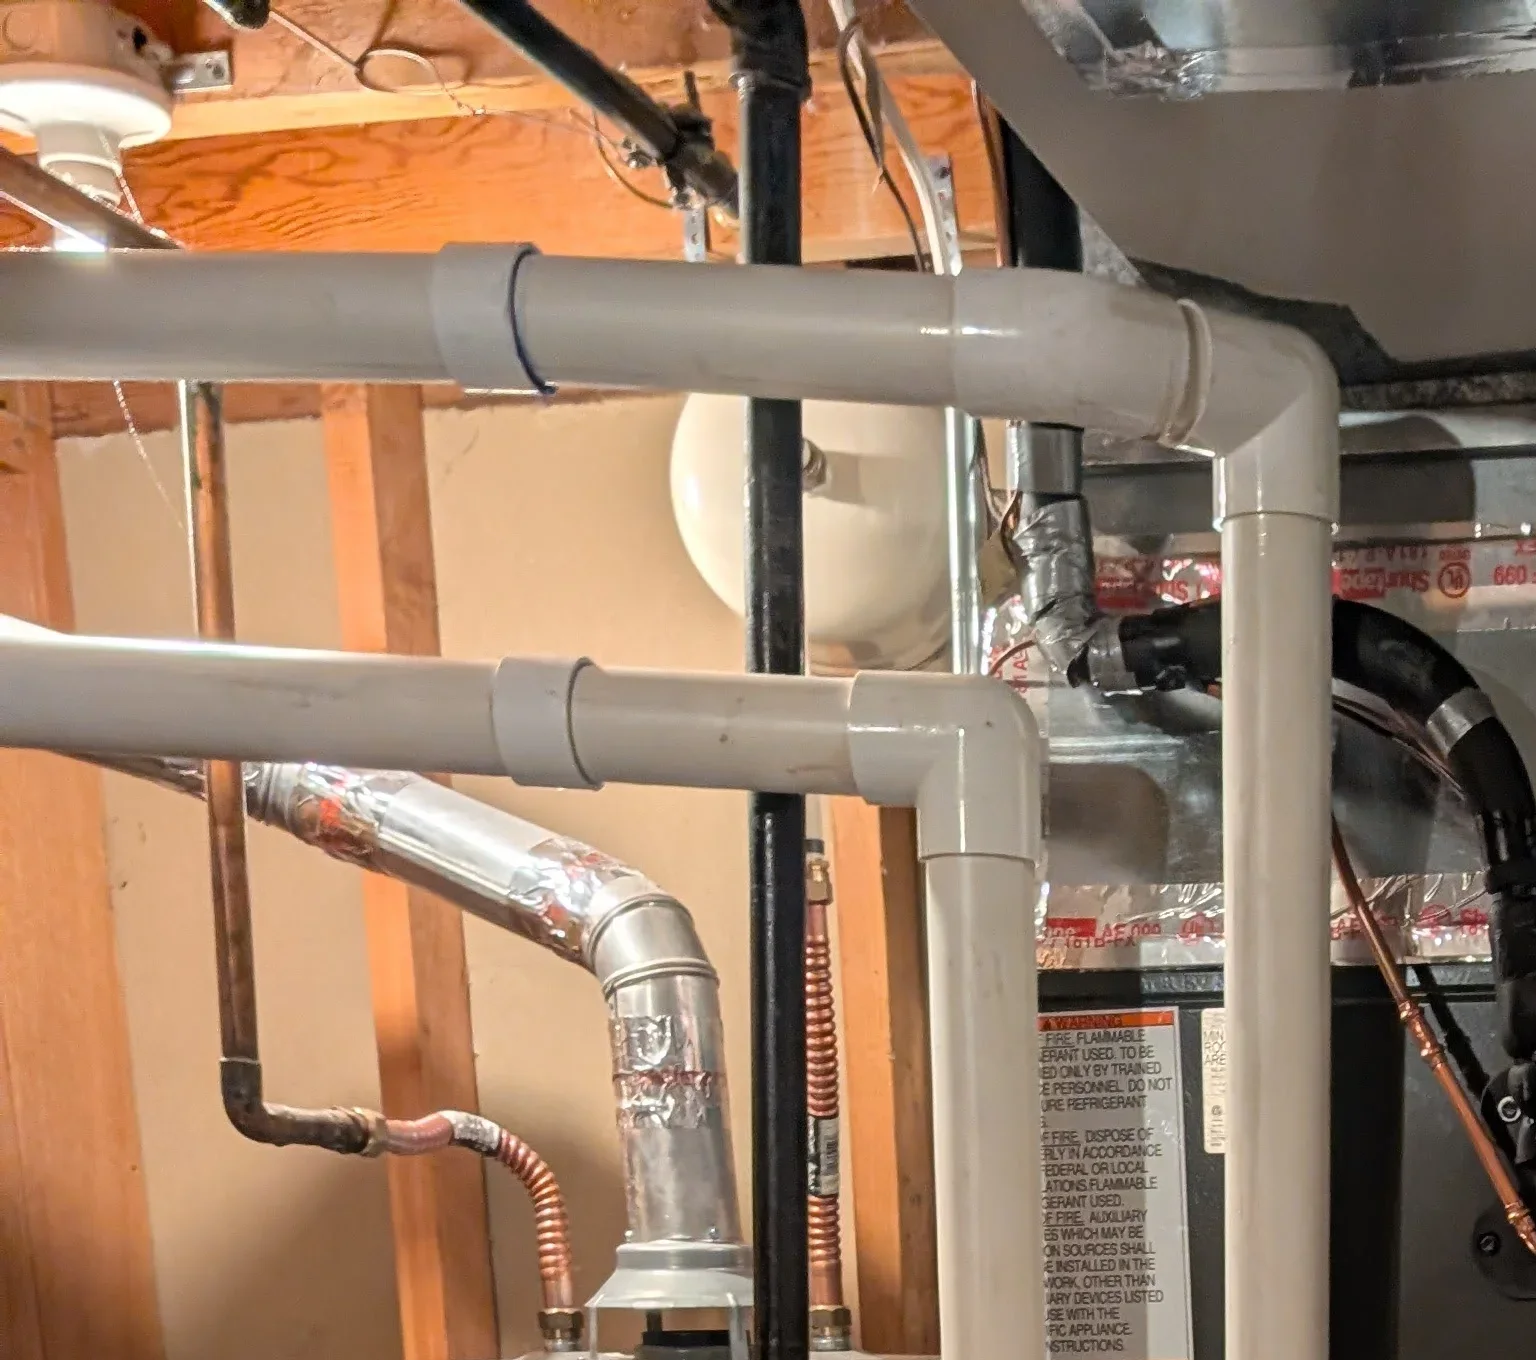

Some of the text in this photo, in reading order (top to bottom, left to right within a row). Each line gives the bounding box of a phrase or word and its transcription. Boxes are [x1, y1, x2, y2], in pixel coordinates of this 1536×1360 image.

[1077, 1029, 1146, 1045] FLAMMABLE
[1041, 1049, 1079, 1063] ERANT
[1120, 1046, 1138, 1060] TO
[1138, 1045, 1155, 1059] BE
[1060, 1064, 1090, 1078] ONLY
[1093, 1063, 1109, 1077] BY
[1111, 1061, 1162, 1076] TRAINED
[1128, 1078, 1144, 1092] DO
[1147, 1077, 1172, 1091] NOT
[1067, 1094, 1148, 1111] REFRIGERANT
[1085, 1128, 1135, 1143] DISPOSE
[1137, 1127, 1154, 1141] OF
[1067, 1146, 1081, 1160] IN
[1082, 1143, 1163, 1160] ACCORDANCE
[1091, 1161, 1109, 1175] OR
[1111, 1160, 1149, 1175] LOCAL
[1090, 1176, 1158, 1191] FLAMMABLE
[1090, 1208, 1148, 1224] AUXILIARY
[1061, 1226, 1099, 1241] WHICH
[1100, 1225, 1125, 1240] MAY
[1128, 1225, 1144, 1239] BE
[1063, 1242, 1118, 1257] SOURCES
[1119, 1241, 1156, 1256] SHALL
[1055, 1257, 1156, 1273] INSTALLED IN THE
[1083, 1274, 1156, 1289] OTHER THAN
[1074, 1291, 1122, 1305] DEVICES
[1123, 1289, 1165, 1304] LISTED
[1065, 1307, 1094, 1321] WITH
[1096, 1306, 1121, 1320] THE
